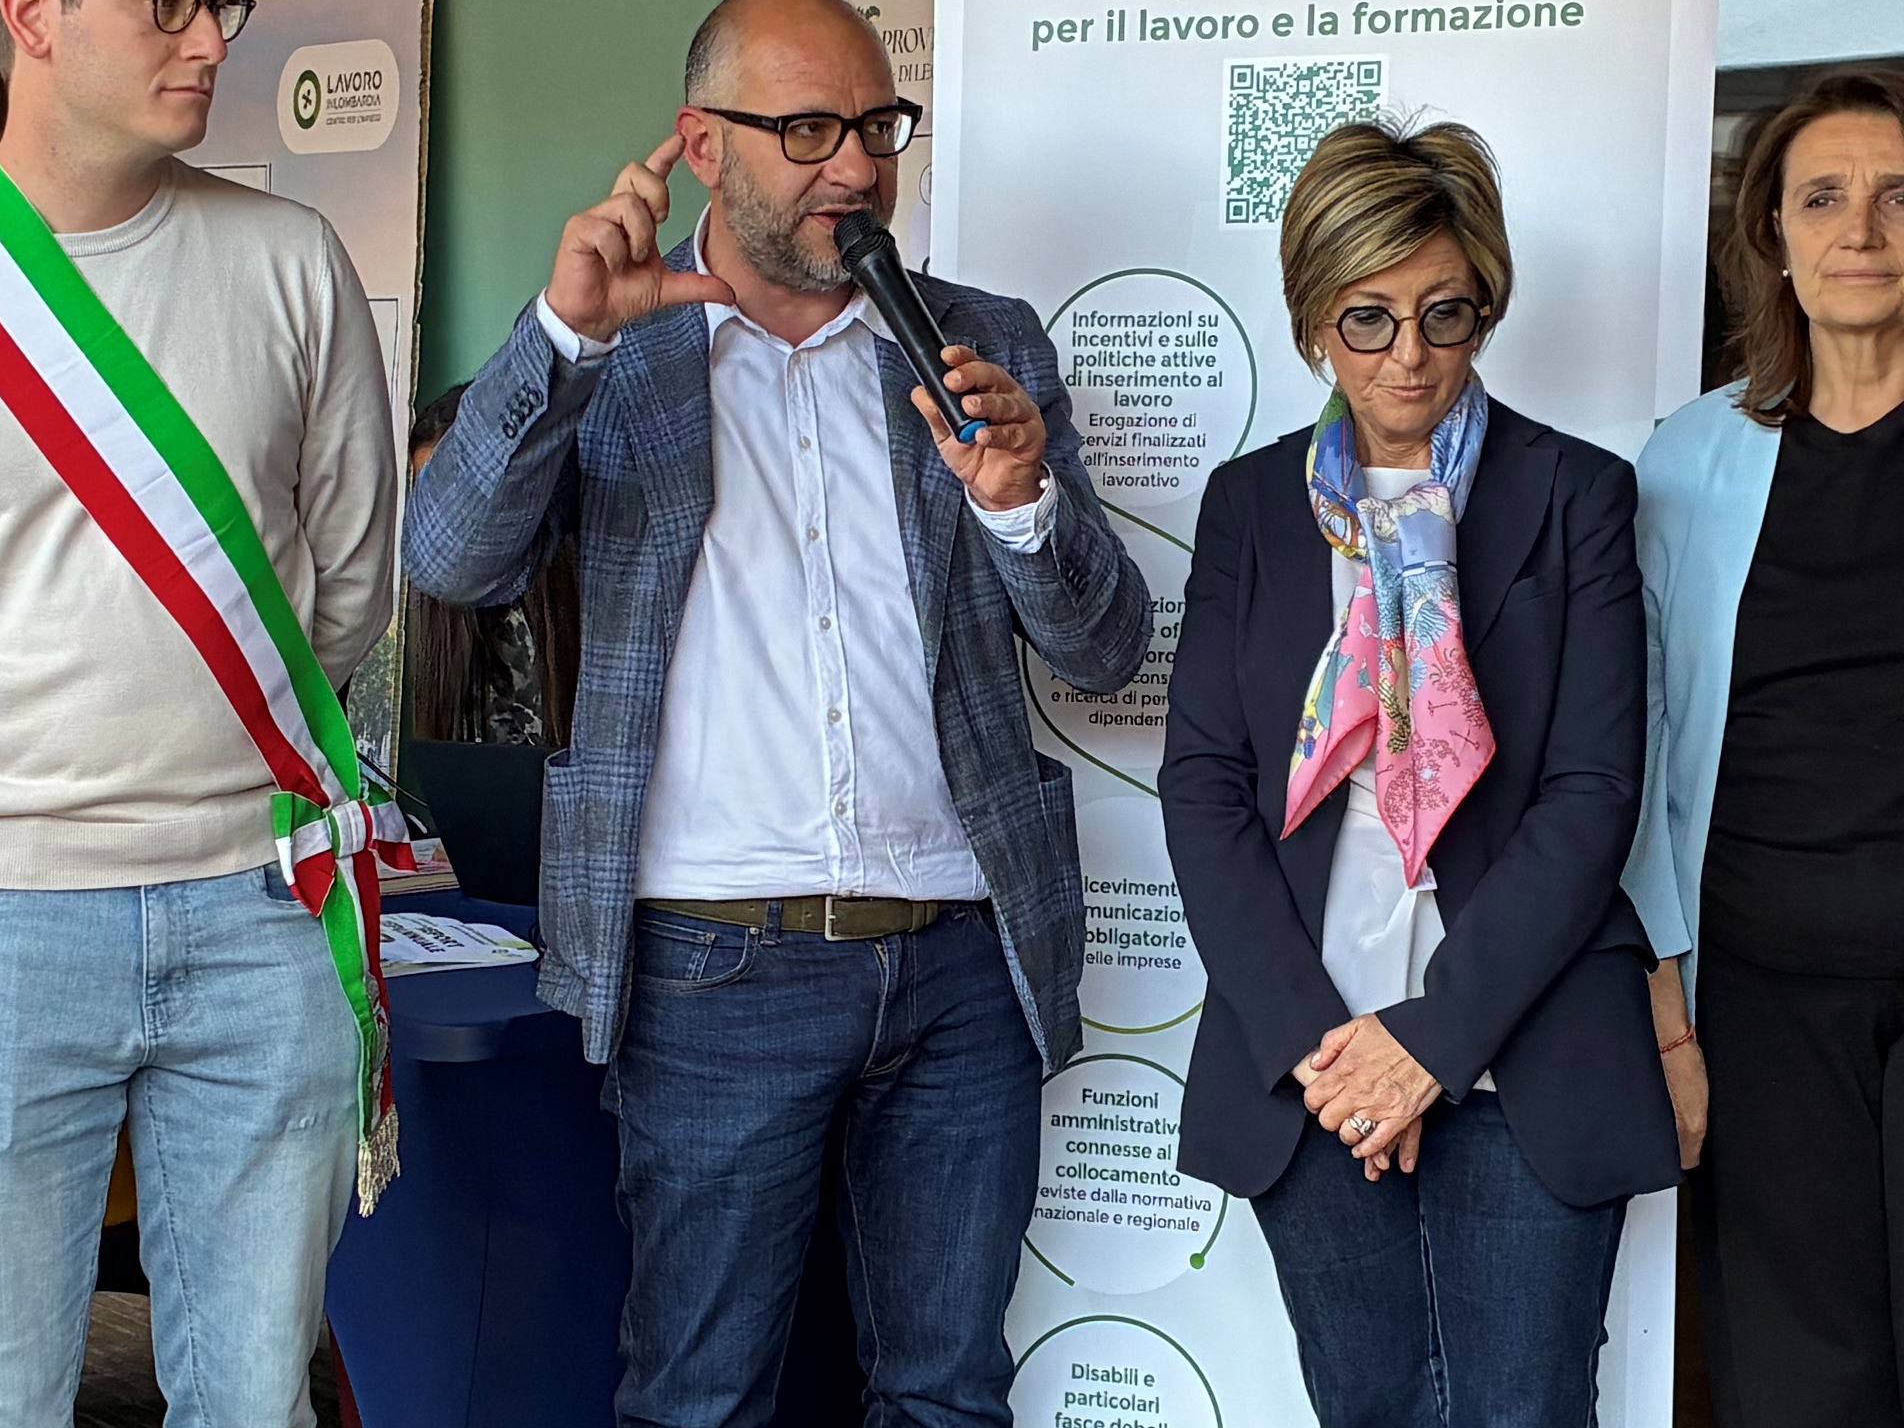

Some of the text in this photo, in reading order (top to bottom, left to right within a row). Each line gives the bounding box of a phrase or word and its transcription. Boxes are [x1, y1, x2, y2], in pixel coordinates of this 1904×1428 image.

[1032, 18, 1094, 51] per
[1106, 9, 1125, 41] il
[1139, 9, 1259, 41] lavoro
[1272, 13, 1294, 37] e
[1307, 3, 1339, 36] la
[327, 70, 382, 94] LAVORO
[1072, 310, 1219, 328] Informazioni su
[1072, 331, 1218, 347] incentivi e sulle
[1073, 351, 1217, 371] politiche attive
[1065, 370, 1223, 387] di inserimento al
[1113, 390, 1173, 407] lavoro
[1089, 413, 1197, 430] Erogazione di
[1080, 432, 1206, 448] servizi finalizzati
[1083, 452, 1199, 467] all'inserimento
[1102, 472, 1180, 488] lavorativo
[1051, 692, 1060, 703] e
[1065, 691, 1118, 704] ricerca
[1122, 691, 1137, 705] di
[1117, 952, 1182, 970] imprese
[1082, 1088, 1159, 1109] Funzioni
[1050, 1114, 1180, 1135] amministrativ
[1066, 1140, 1171, 1160] connesse al
[1055, 1162, 1180, 1187] collocamento
[1090, 1187, 1127, 1204] dalla
[1132, 1195, 1212, 1212] normativa
[1034, 1206, 1200, 1232] nazionale e regionale
[1071, 1363, 1155, 1387] Disabili e
[1064, 1391, 1160, 1414] particolari
